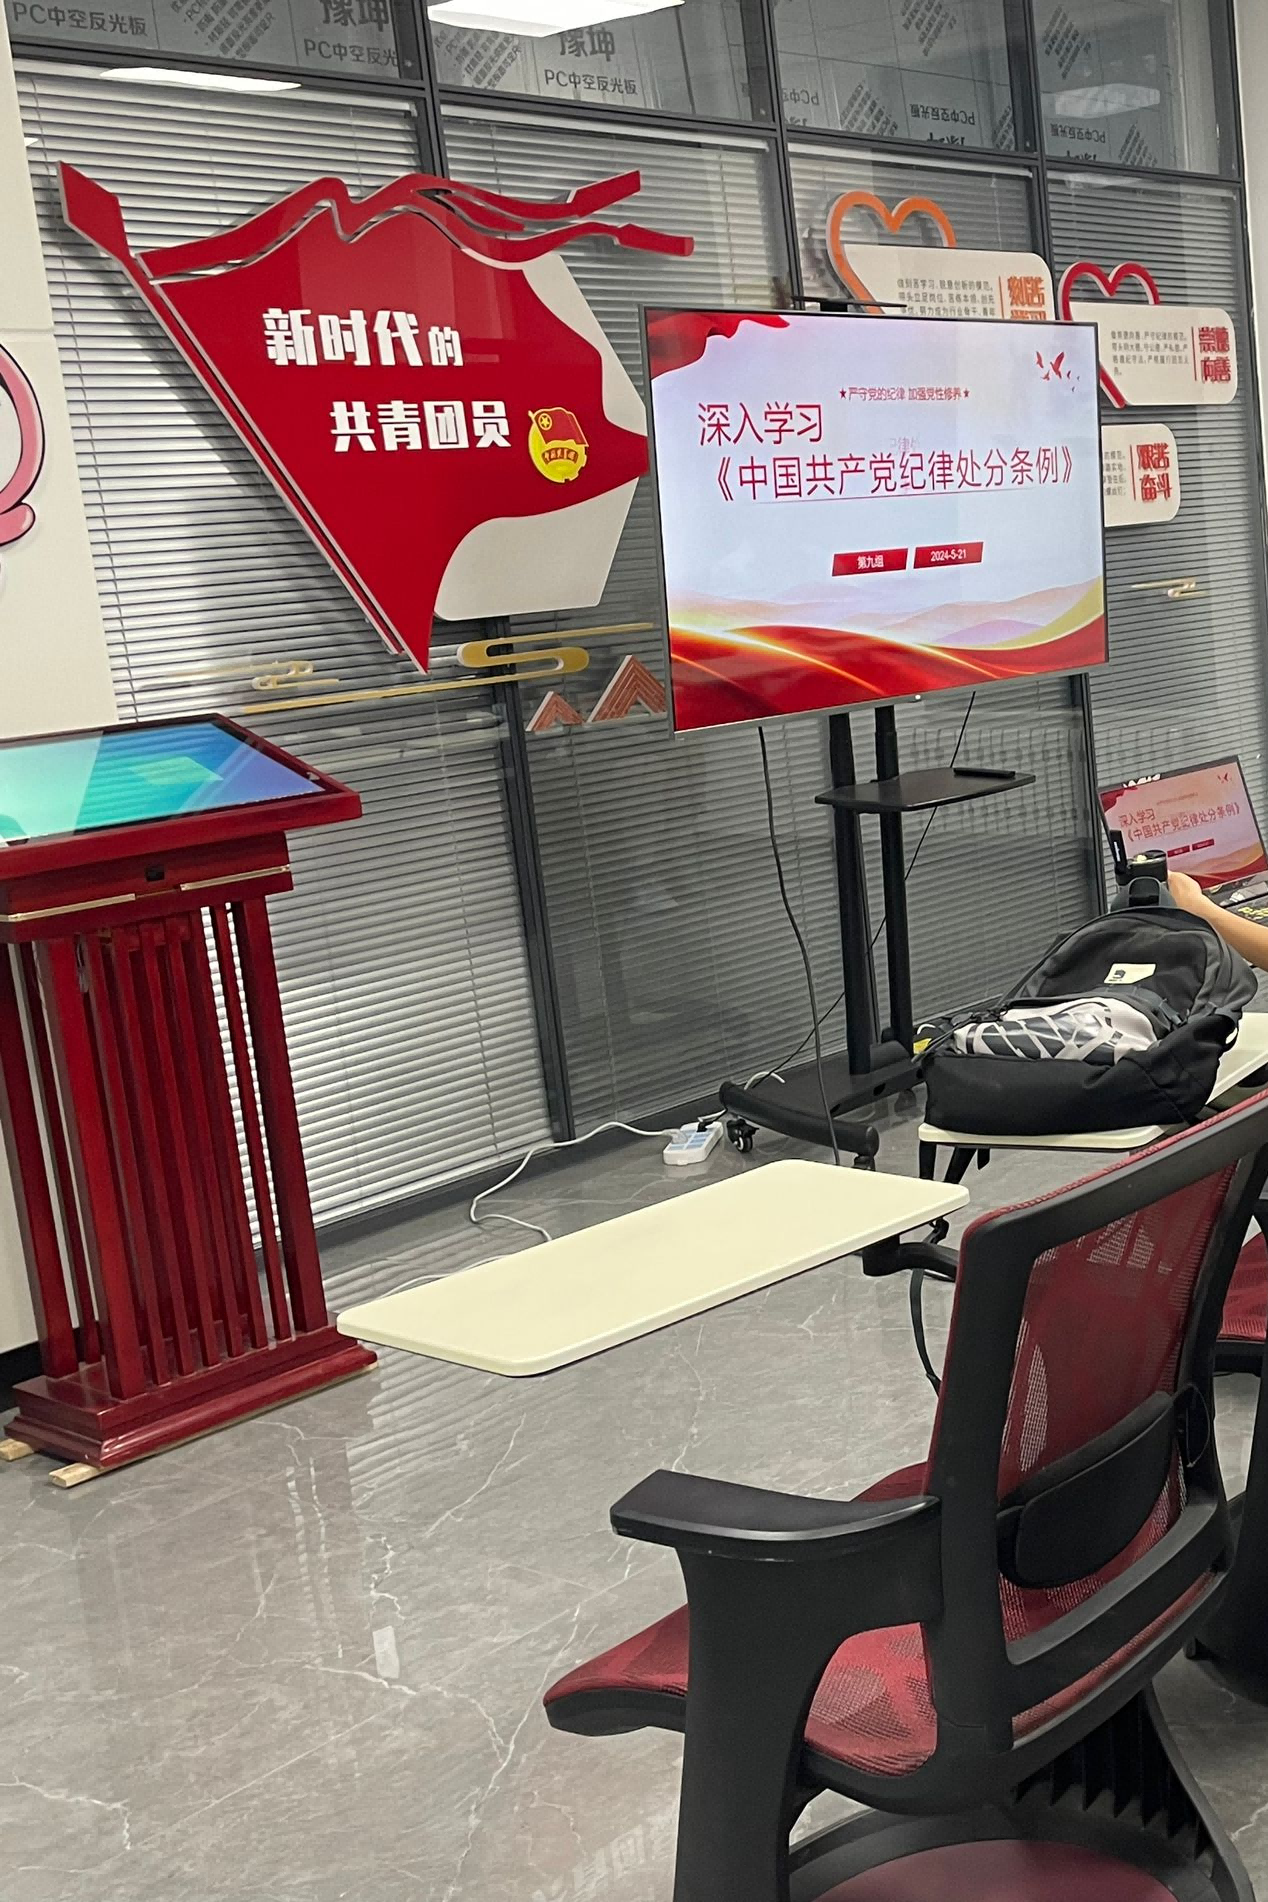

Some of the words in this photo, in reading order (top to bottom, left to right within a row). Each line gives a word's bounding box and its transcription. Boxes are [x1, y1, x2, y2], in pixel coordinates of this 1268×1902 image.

[12, 2, 148, 37] PC中空反光板
[544, 69, 638, 95] PC中空反光板
[263, 307, 464, 366] 新时代的
[848, 386, 906, 400] 严守党的纪律
[908, 387, 962, 400] 加强党性修养
[329, 401, 512, 453] 共青团员
[698, 403, 824, 446] 深入学习
[716, 446, 1073, 501] 《中国共产党纪律处分条例》
[857, 555, 884, 569] 第九组
[930, 549, 967, 562] 2024-5-21
